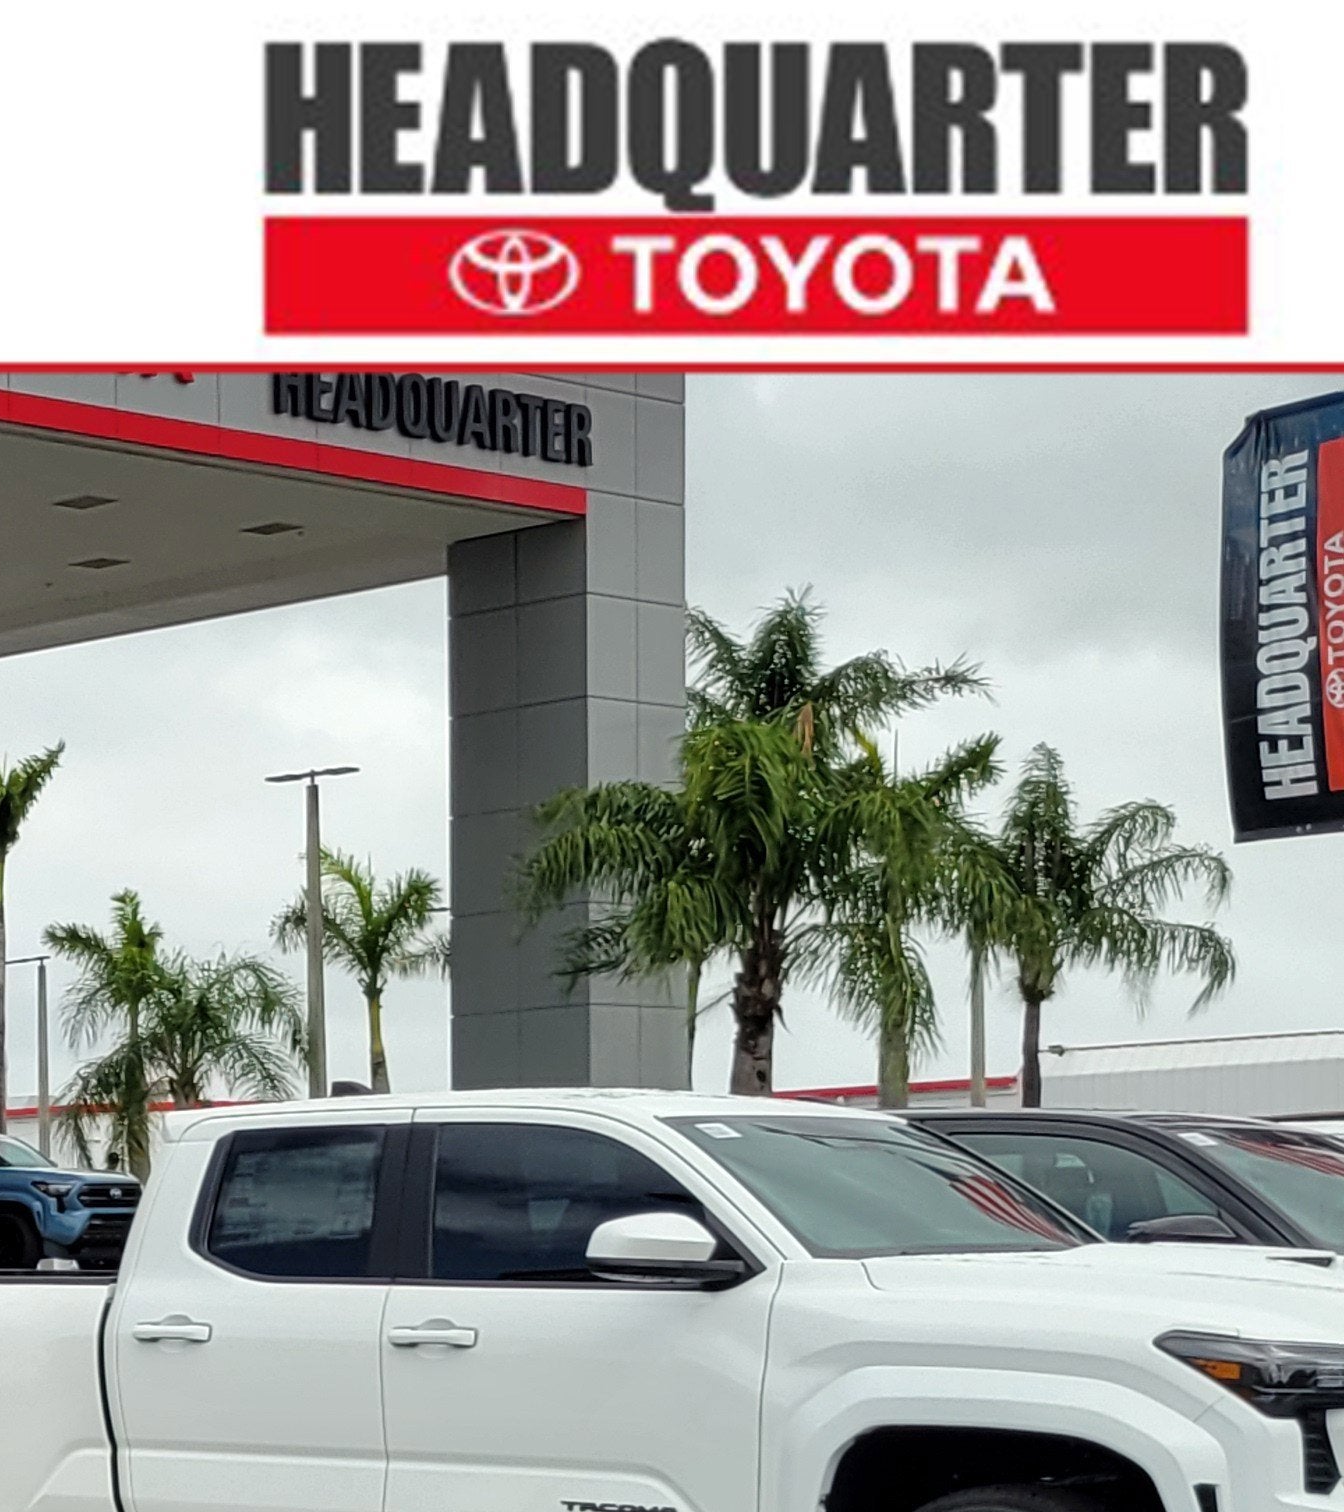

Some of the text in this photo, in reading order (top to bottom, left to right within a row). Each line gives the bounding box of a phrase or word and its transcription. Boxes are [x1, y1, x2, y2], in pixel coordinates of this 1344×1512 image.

[273, 373, 593, 467] HEADQUARTER
[1256, 449, 1318, 800] HEADQUARTER
[1324, 530, 1344, 666] TOYOTA
